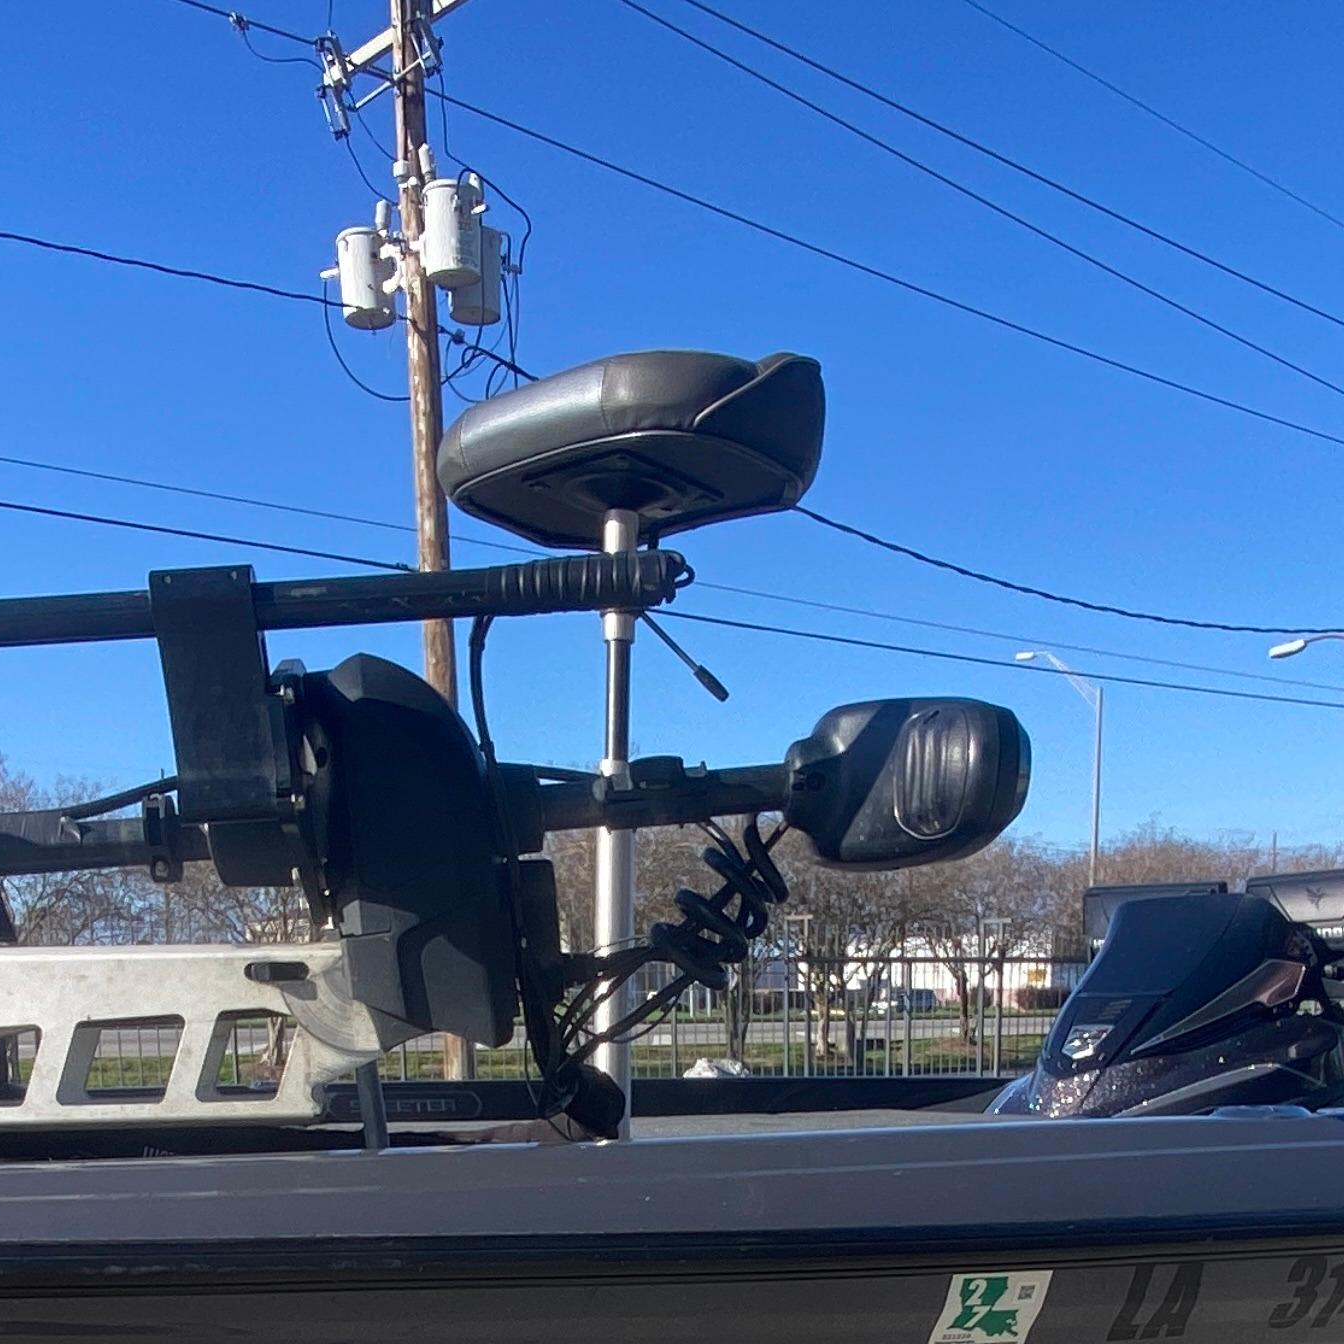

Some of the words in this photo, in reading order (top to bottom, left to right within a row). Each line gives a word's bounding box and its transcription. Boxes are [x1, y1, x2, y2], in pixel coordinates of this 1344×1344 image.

[964, 1278, 988, 1306] 2
[1106, 1261, 1205, 1342] LA
[963, 1304, 992, 1329] 7
